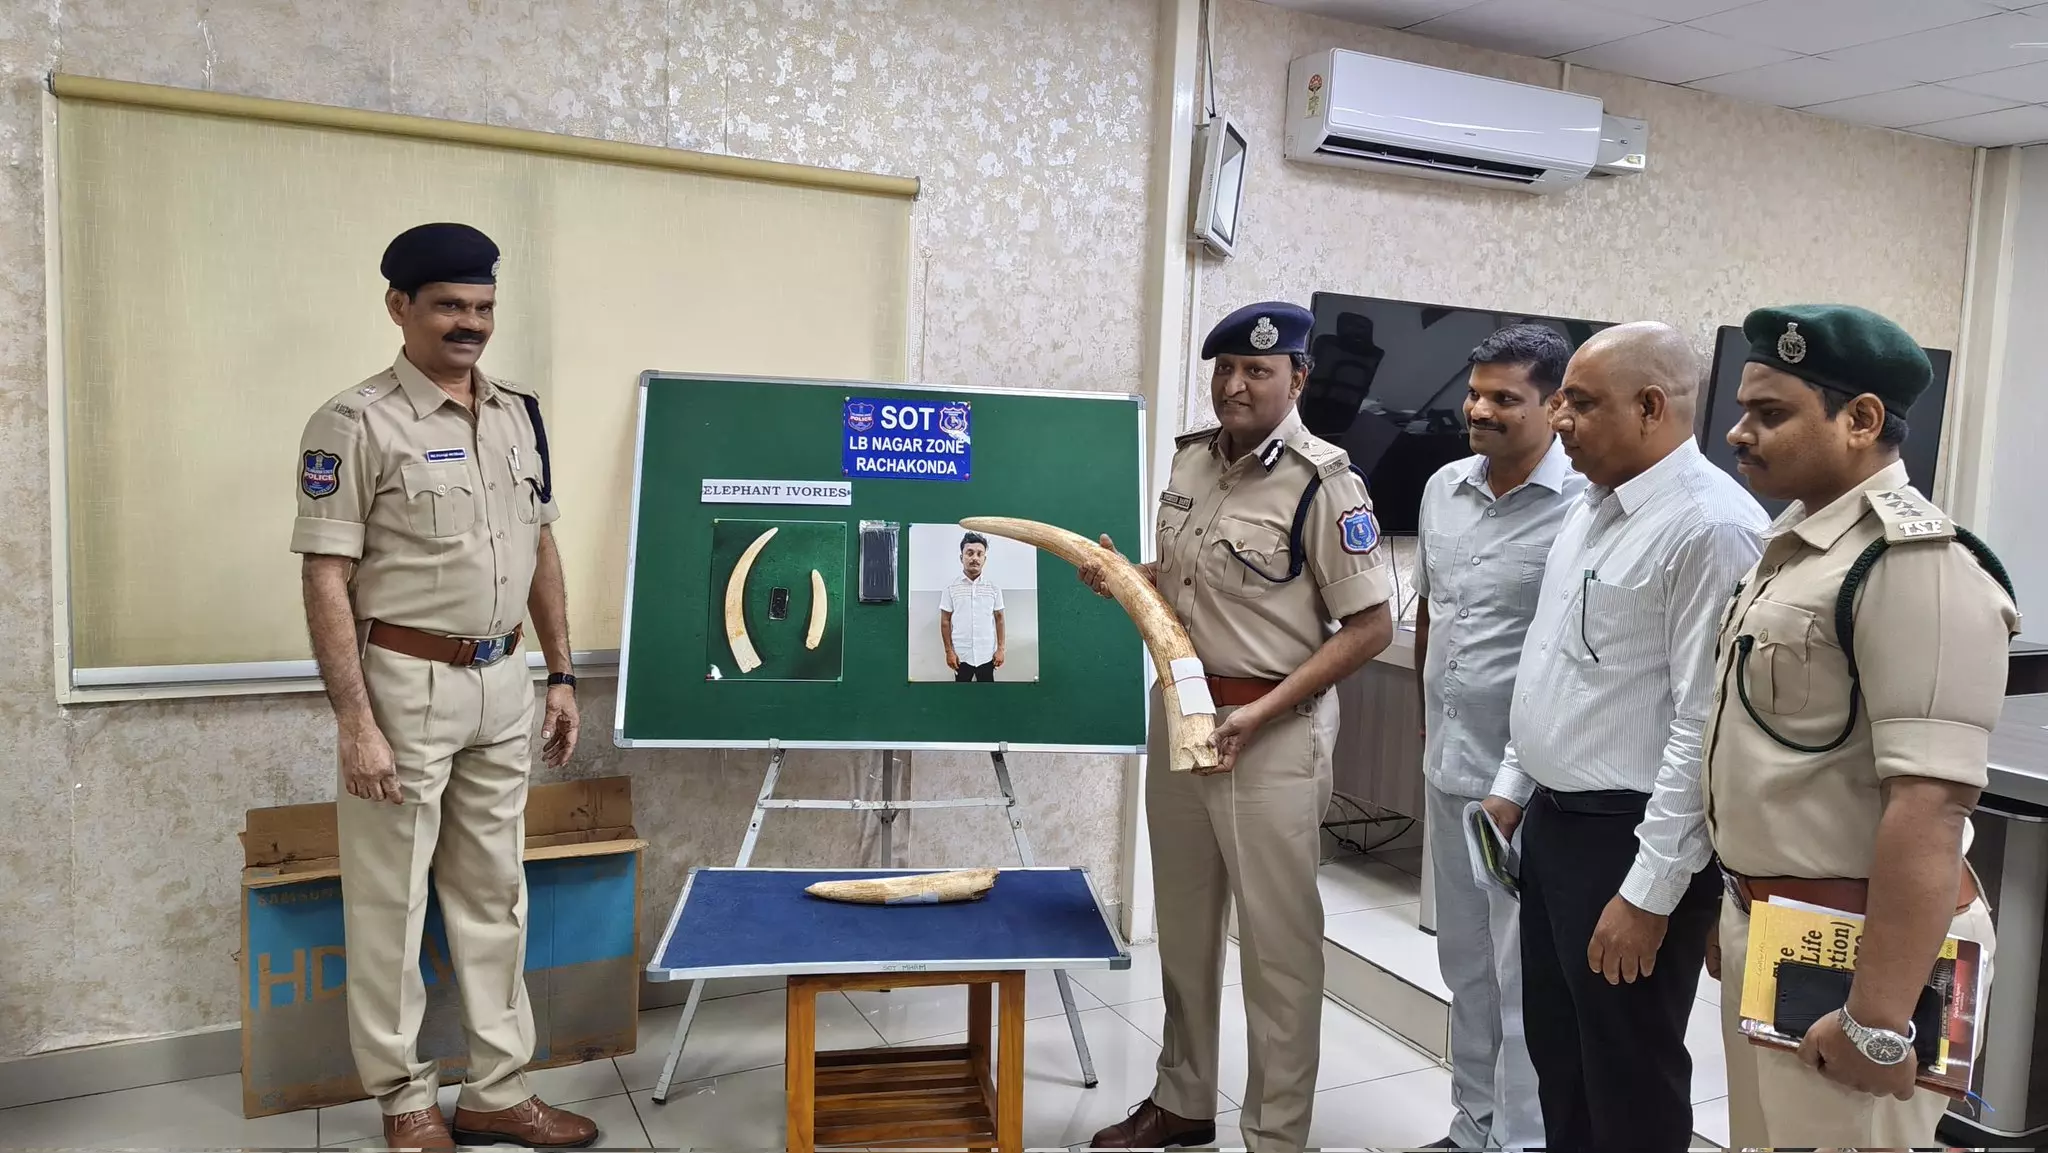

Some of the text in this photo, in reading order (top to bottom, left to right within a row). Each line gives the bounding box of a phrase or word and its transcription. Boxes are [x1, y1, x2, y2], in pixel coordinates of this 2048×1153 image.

[880, 405, 935, 430] SOT
[849, 436, 965, 454] LB NAGAR ZONE
[856, 457, 957, 475] RACHAKONDA
[304, 471, 335, 481] POLICE
[703, 485, 847, 498] ELEPHANT IVORIES
[257, 887, 343, 907] SAMSUN
[1801, 929, 1823, 964] Life
